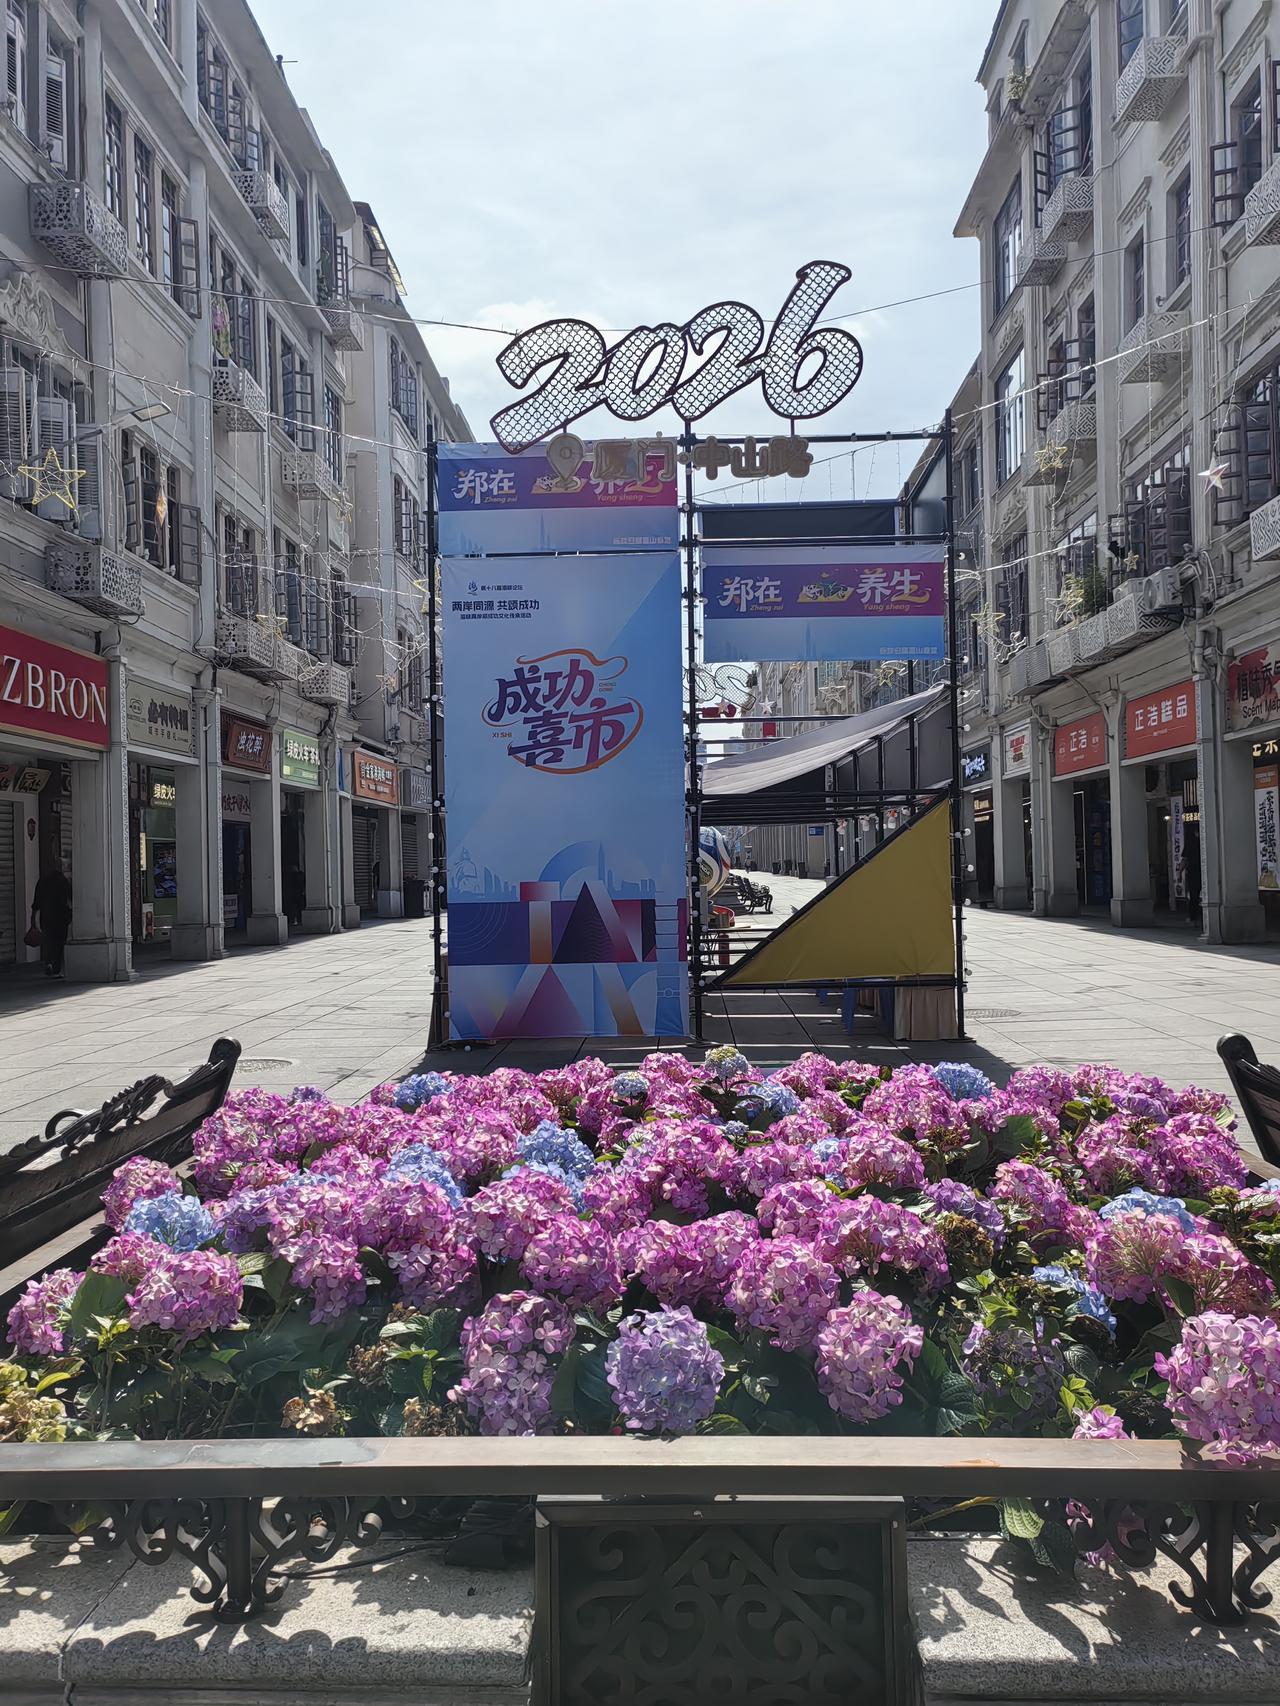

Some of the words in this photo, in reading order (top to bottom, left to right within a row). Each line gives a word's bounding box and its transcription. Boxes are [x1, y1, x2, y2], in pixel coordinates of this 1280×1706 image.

[490, 260, 863, 454] 2026
[452, 469, 516, 504] 郑在
[719, 576, 783, 612] 郑在
[856, 568, 931, 604] 养生
[452, 600, 495, 612] 两岸同源
[497, 599, 540, 611] 共颂成功
[487, 658, 595, 723] 成功
[508, 698, 635, 768] 喜市
[1069, 729, 1088, 752] 正浩
